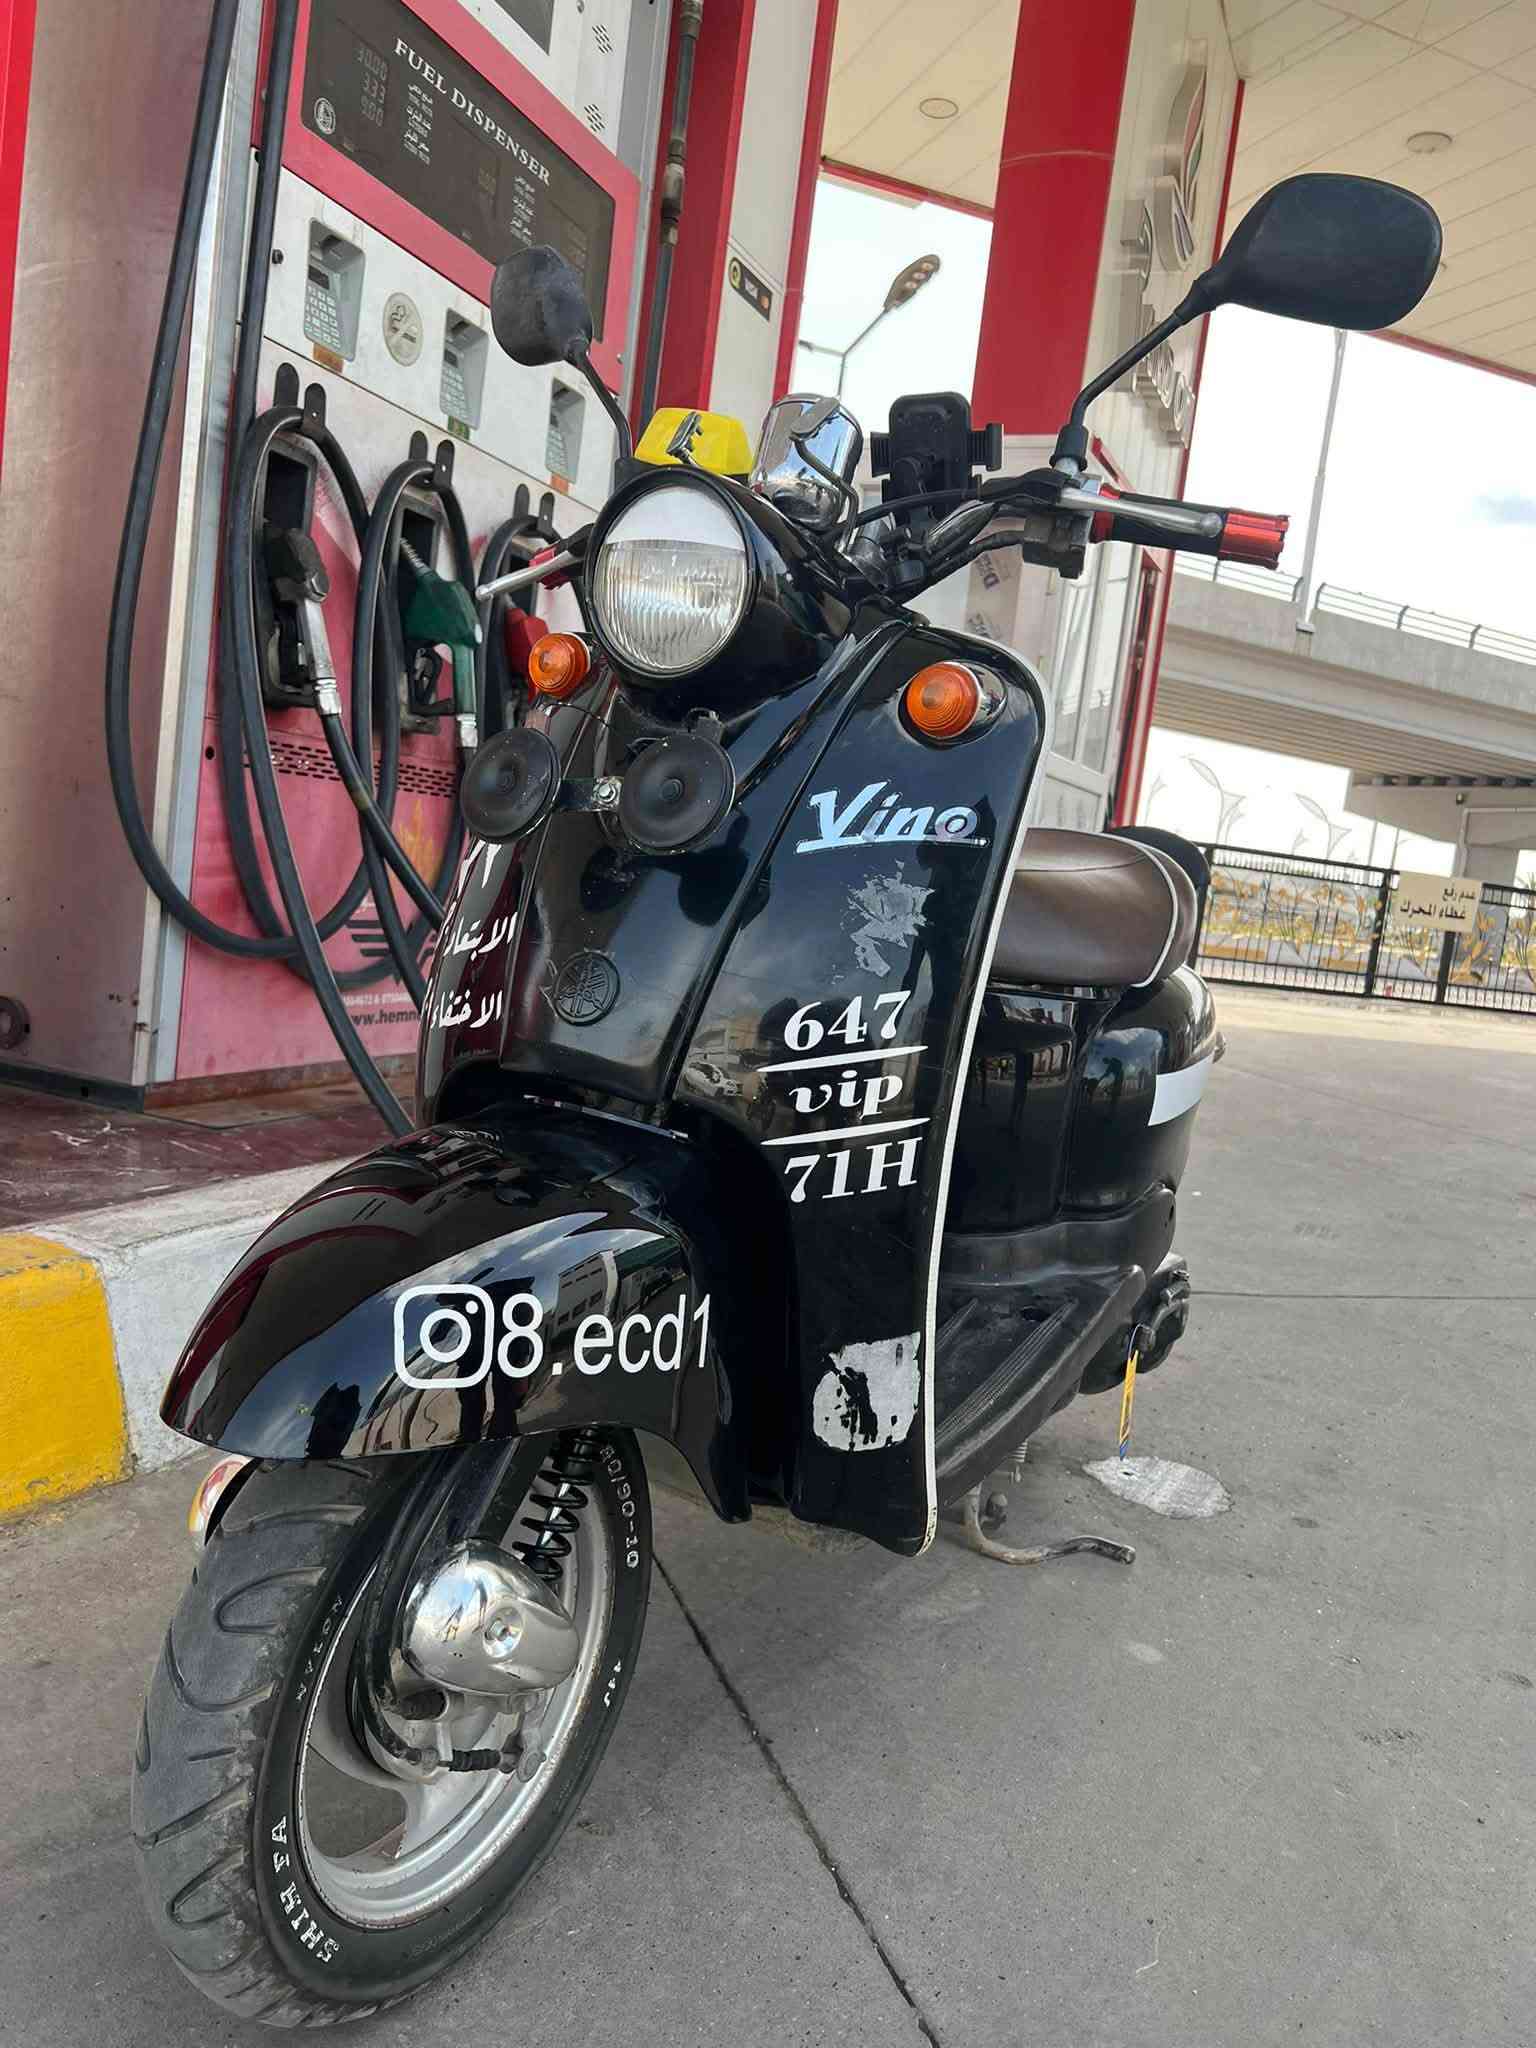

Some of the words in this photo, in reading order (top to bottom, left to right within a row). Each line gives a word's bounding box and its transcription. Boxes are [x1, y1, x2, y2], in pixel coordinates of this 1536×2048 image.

[394, 38, 447, 94] FUEL
[450, 87, 551, 187] DISPENSER
[799, 780, 988, 852] Vino
[430, 988, 503, 1029] الاختفاء
[783, 990, 912, 1052] 647
[788, 1069, 904, 1121] vip
[783, 1136, 924, 1204] 71H
[496, 1292, 711, 1379] 8.ecd1
